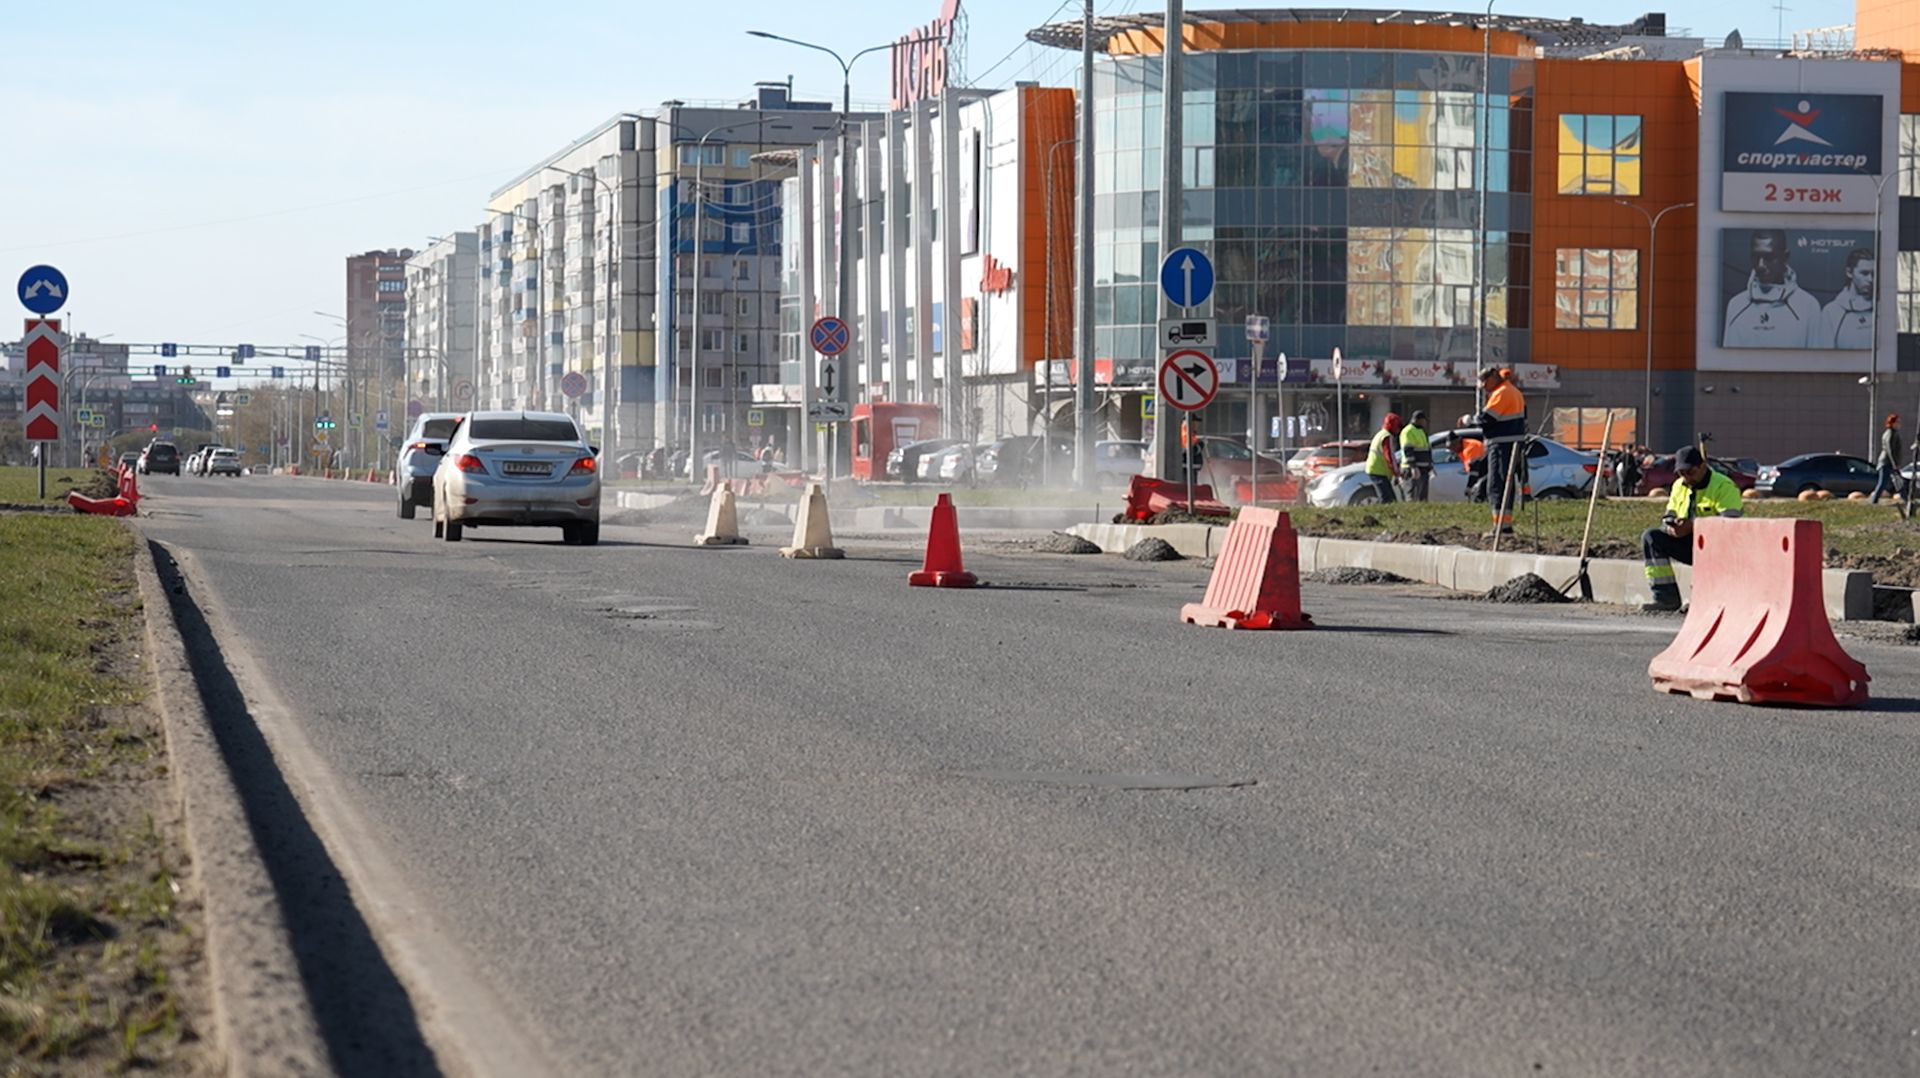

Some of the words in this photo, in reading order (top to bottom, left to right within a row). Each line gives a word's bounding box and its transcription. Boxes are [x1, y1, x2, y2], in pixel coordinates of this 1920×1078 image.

[1738, 152, 1867, 169] спортмастер
[1765, 184, 1777, 201] 2
[1783, 188, 1842, 202] этаж
